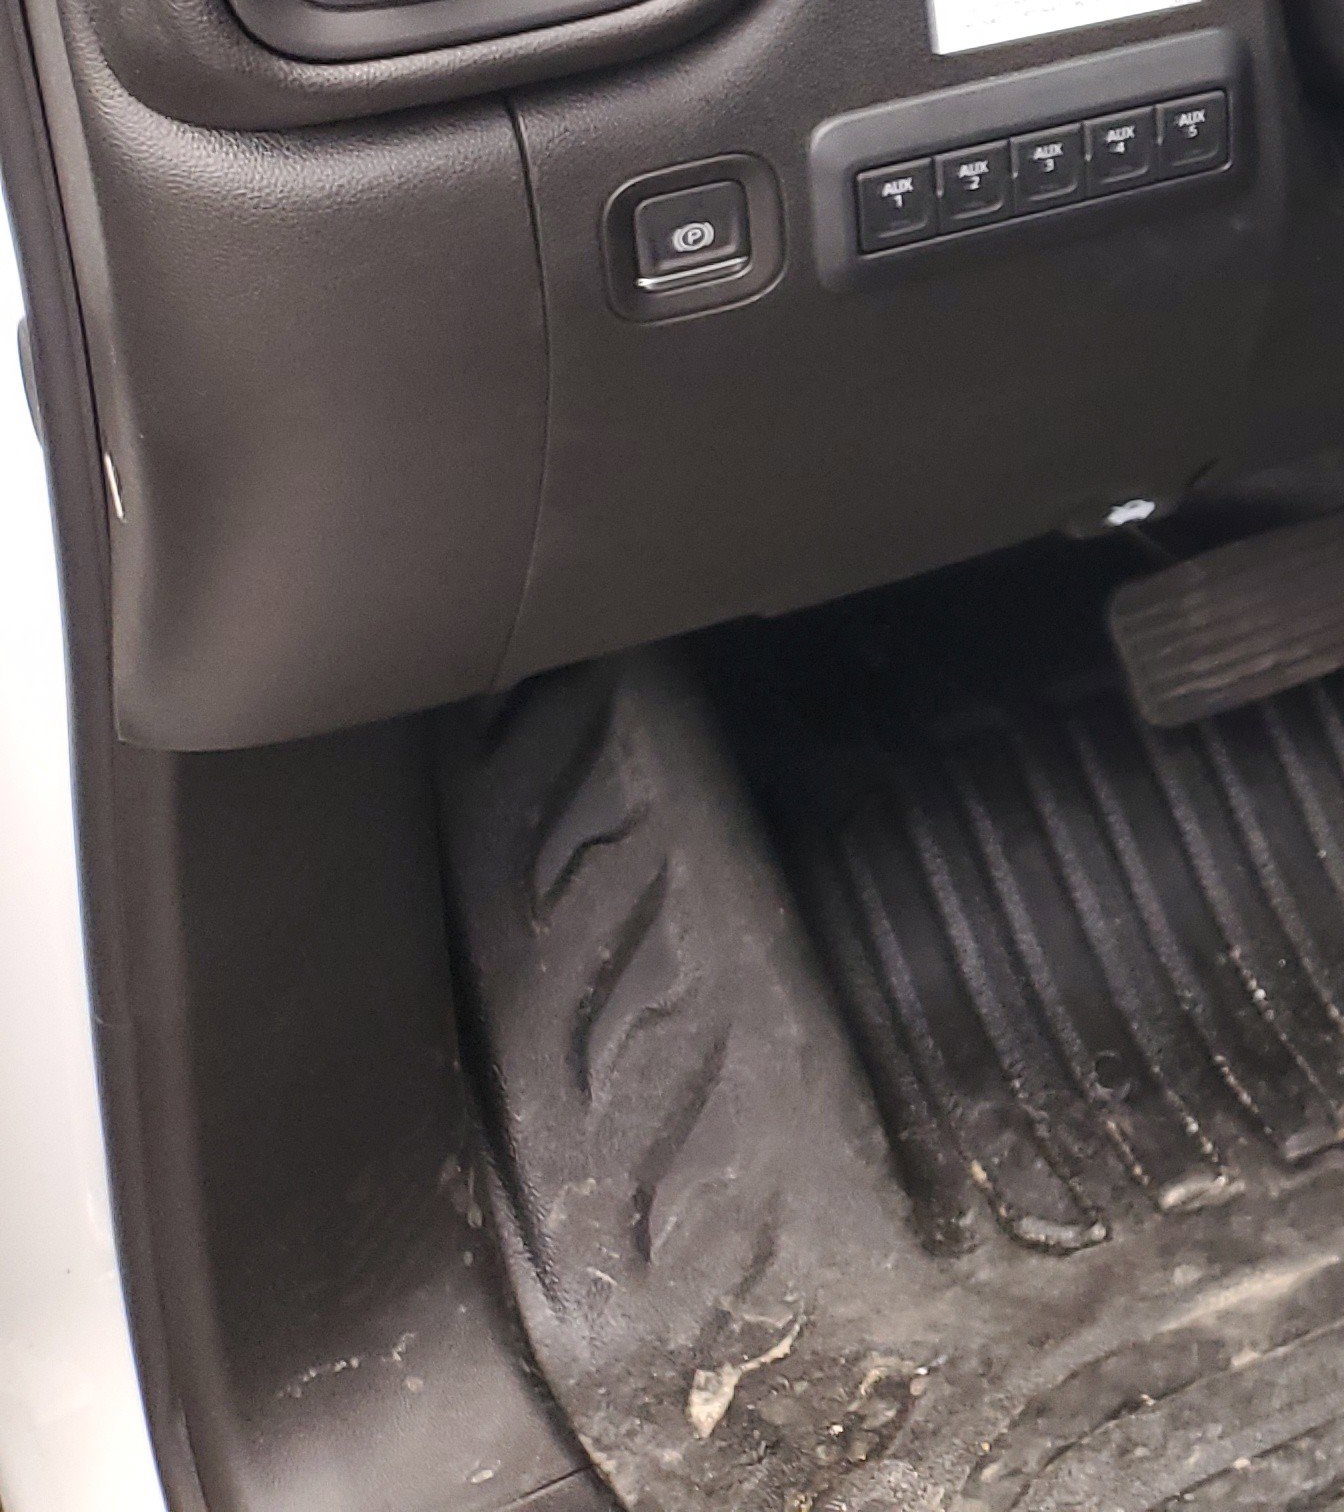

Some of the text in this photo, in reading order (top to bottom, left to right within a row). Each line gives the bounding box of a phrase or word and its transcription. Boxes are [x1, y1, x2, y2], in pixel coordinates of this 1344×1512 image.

[1177, 109, 1206, 127] AUX
[1105, 126, 1134, 144] AUX
[1188, 125, 1198, 139] 5
[1034, 143, 1063, 161] AUX
[1114, 141, 1126, 154] 4
[959, 160, 988, 178] AUX
[1044, 159, 1055, 172] 3
[882, 178, 913, 197] AUX
[968, 176, 980, 190] 2
[894, 195, 903, 208] 1
